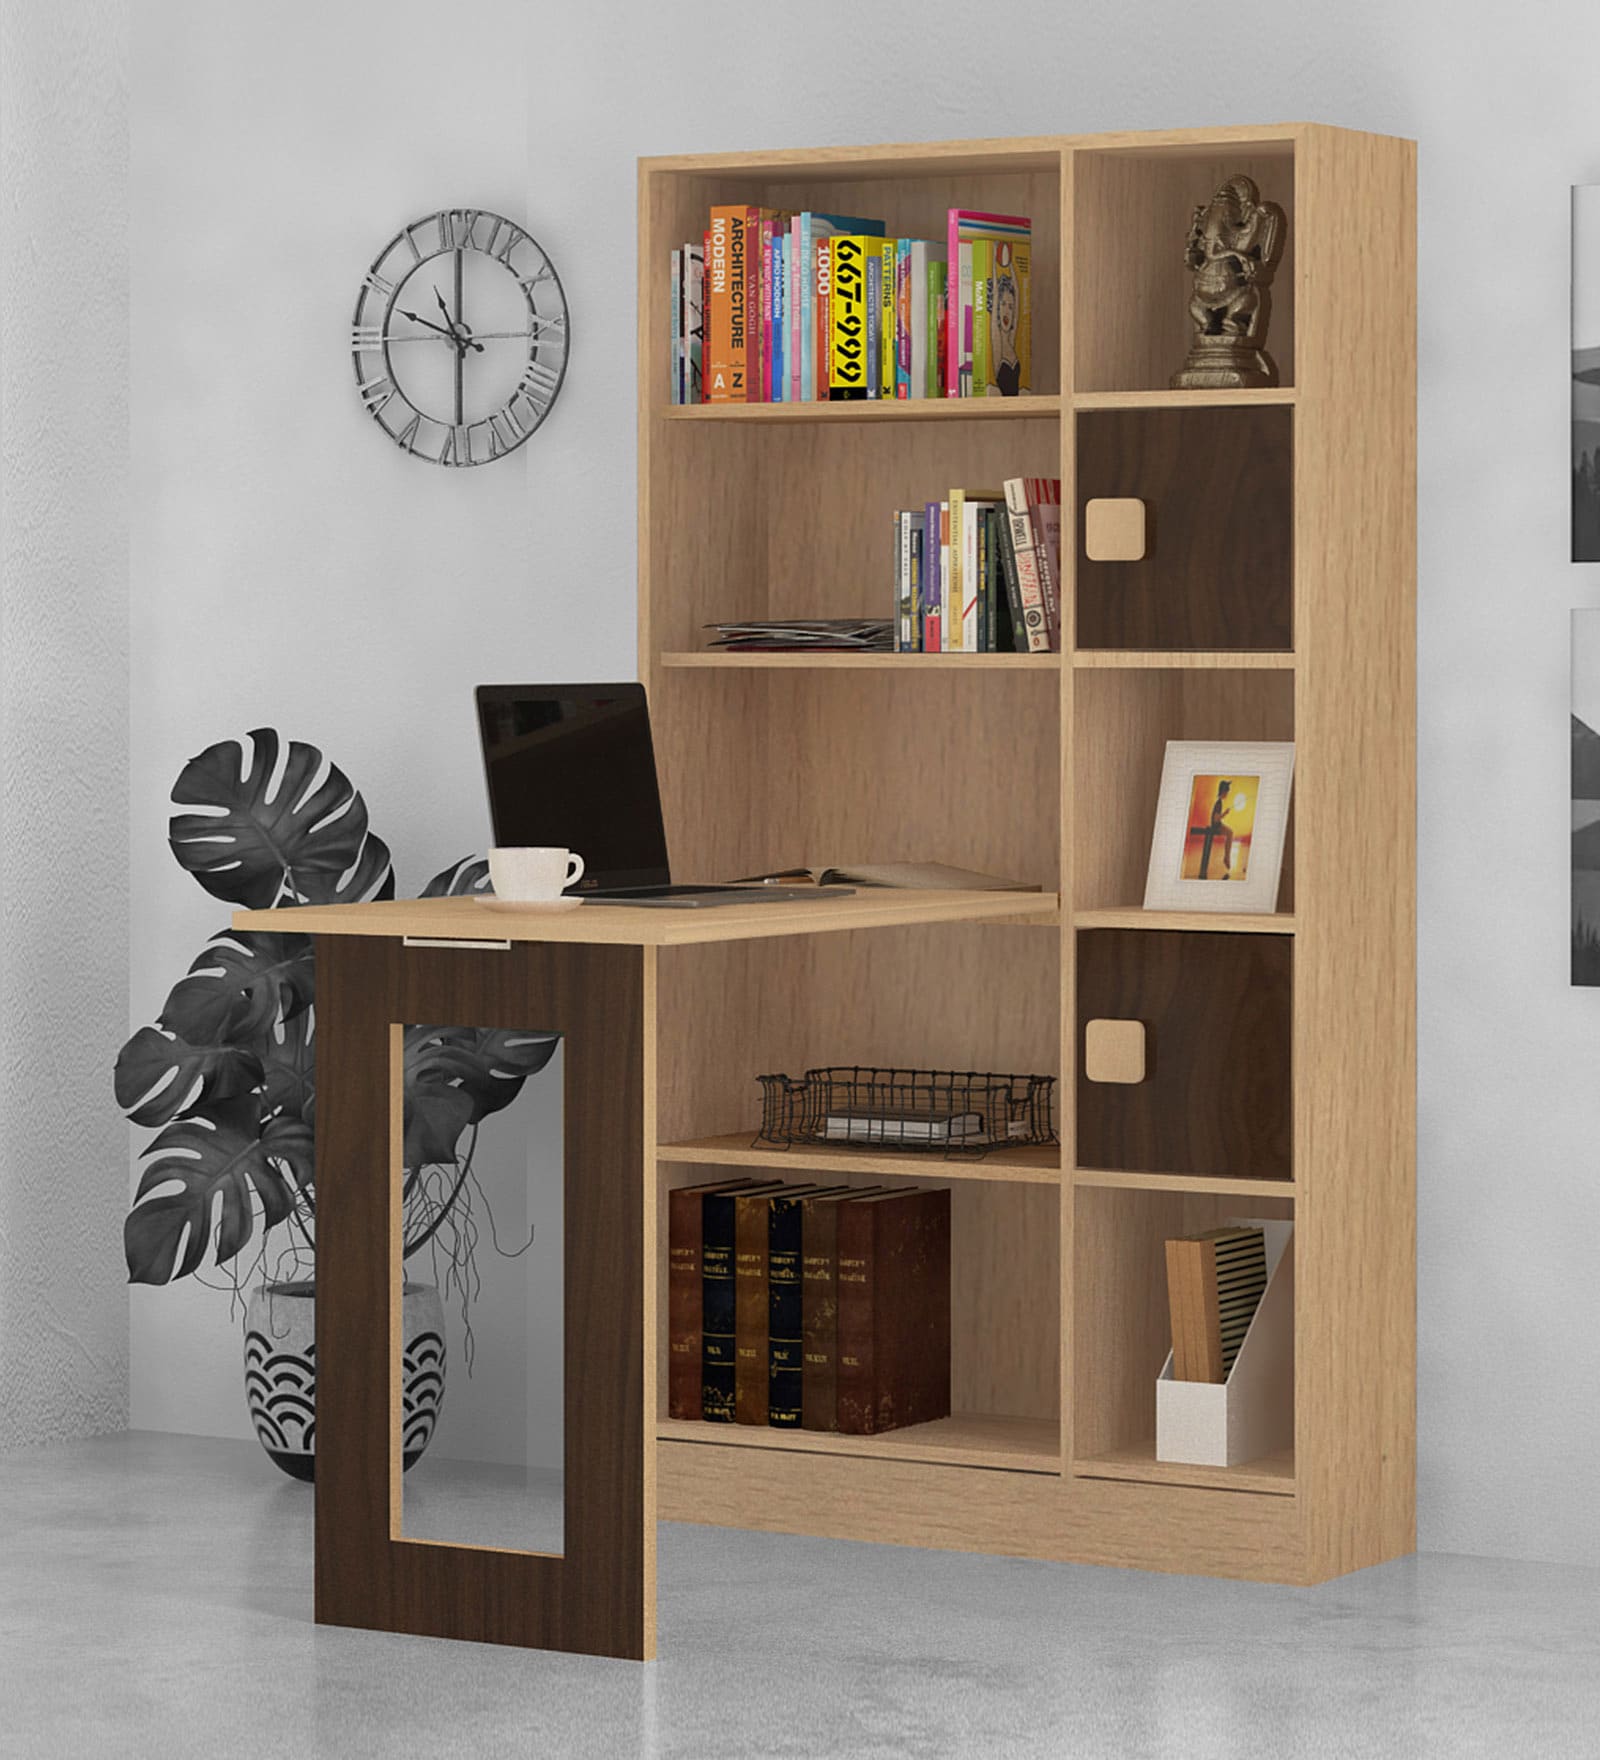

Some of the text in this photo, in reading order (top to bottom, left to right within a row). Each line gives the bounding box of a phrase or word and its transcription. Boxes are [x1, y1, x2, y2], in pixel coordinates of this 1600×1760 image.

[712, 217, 726, 294] MODERN
[731, 217, 744, 349] ARCHITECTURE
[818, 246, 830, 295] 1000
[883, 246, 891, 308] PATTERNS
[837, 240, 862, 383] 667-999
[975, 281, 983, 312] MoMA
[713, 373, 725, 388] A
[732, 373, 743, 388] Z
